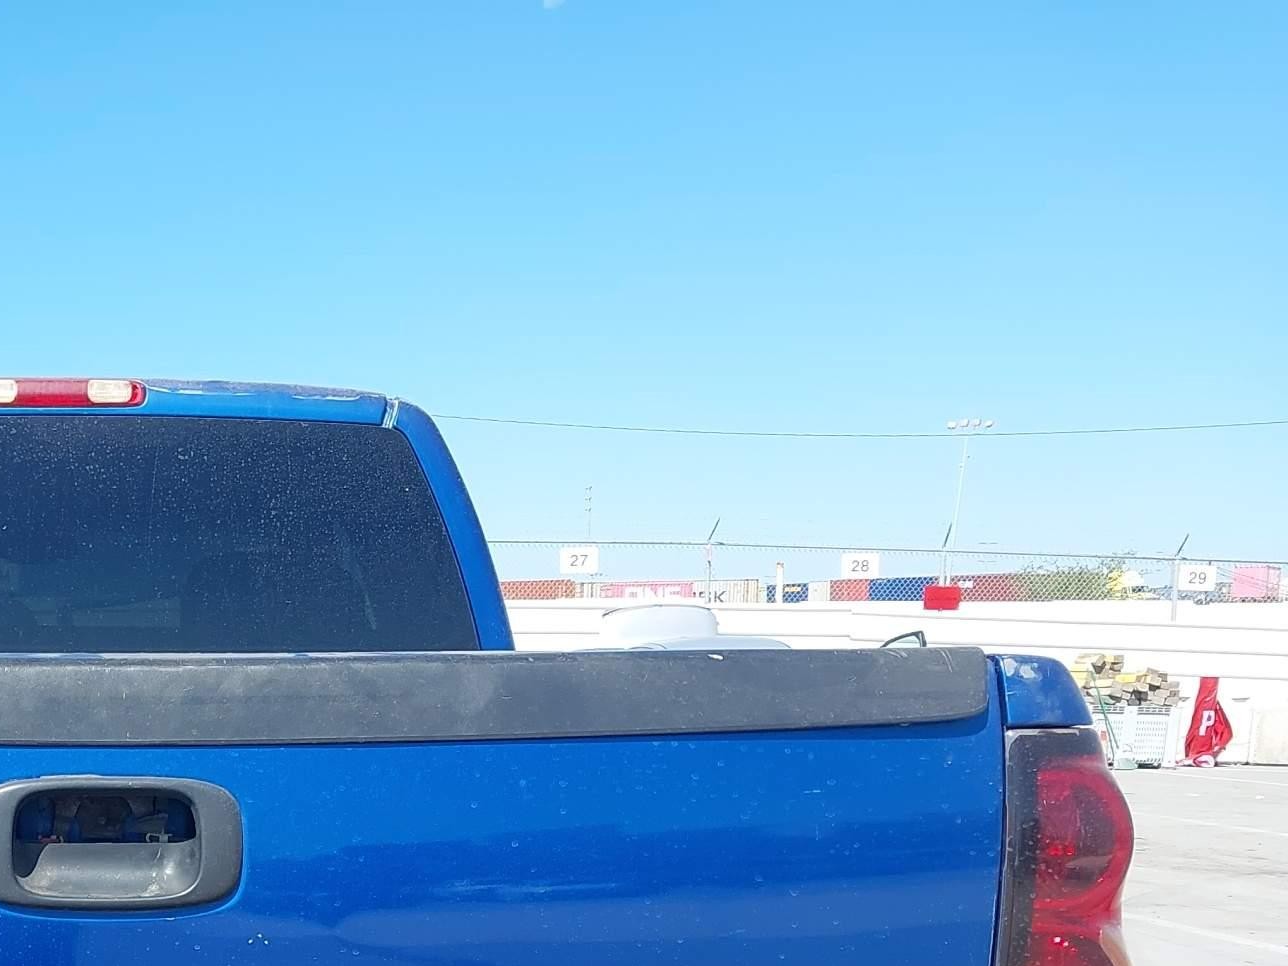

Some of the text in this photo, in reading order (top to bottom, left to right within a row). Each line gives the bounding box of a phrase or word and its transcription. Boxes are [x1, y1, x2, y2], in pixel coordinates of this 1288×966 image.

[570, 554, 588, 567] 27
[851, 560, 870, 572] 28
[1187, 571, 1207, 585] 29
